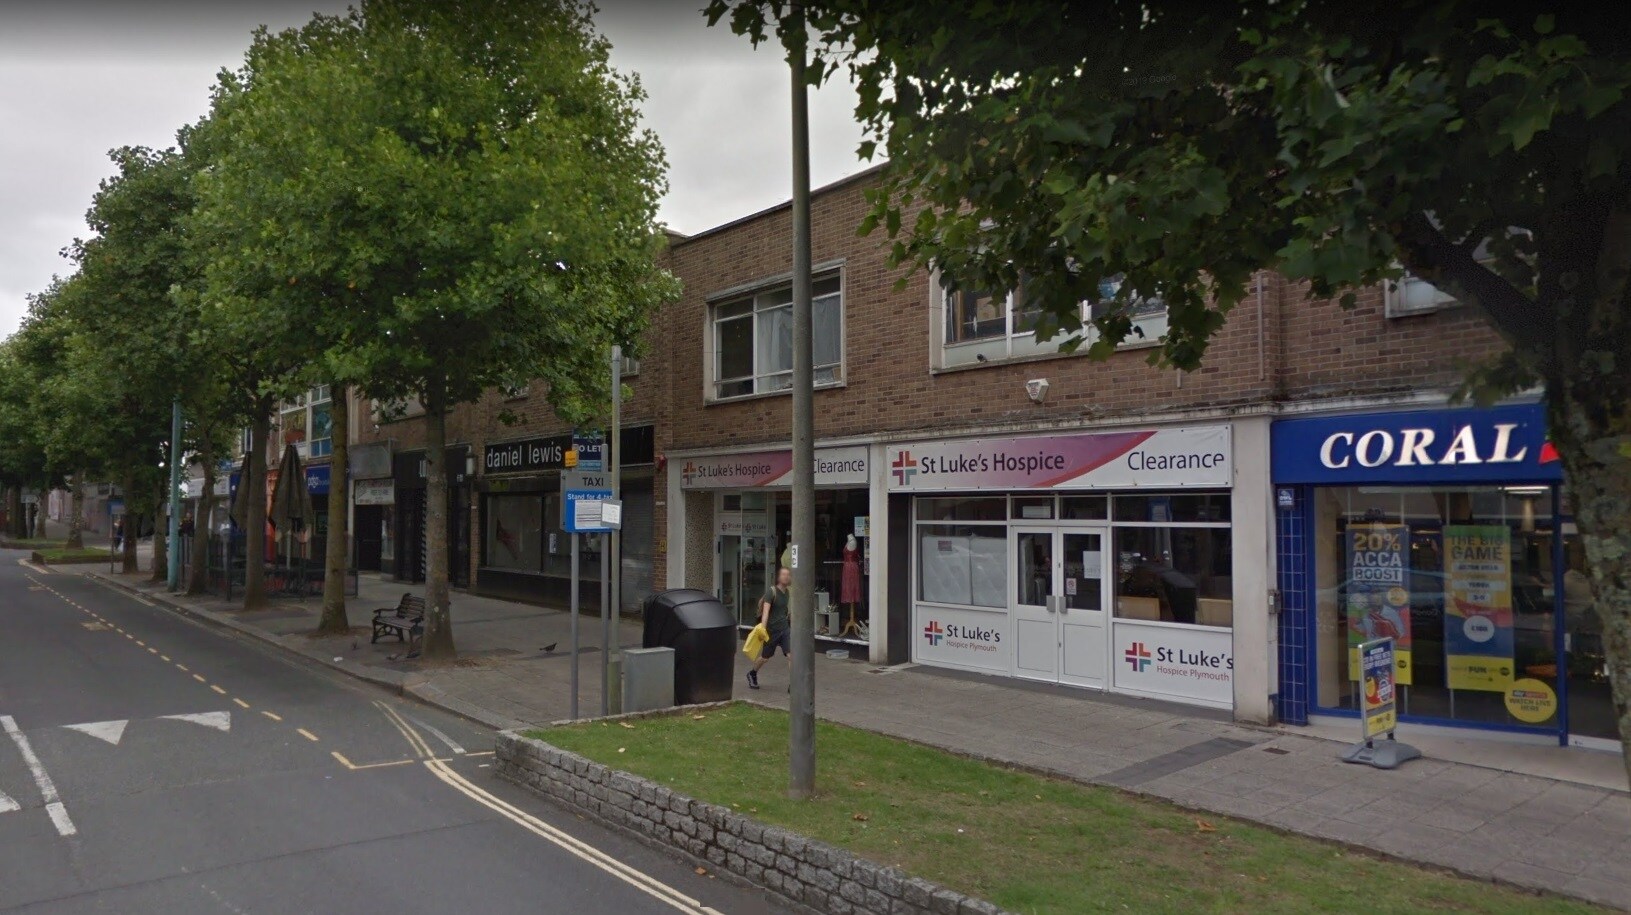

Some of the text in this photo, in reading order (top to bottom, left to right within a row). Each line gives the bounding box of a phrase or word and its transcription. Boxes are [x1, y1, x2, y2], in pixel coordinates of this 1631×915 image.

[487, 442, 562, 468] daniel lewis
[1320, 423, 1527, 469] CORAL
[921, 451, 1065, 475] St Luke's Hospice
[1127, 449, 1225, 471] Clearance
[697, 462, 771, 481] St Luke's Hospice
[582, 476, 604, 487] TAXI
[1353, 533, 1401, 552] 20%
[1353, 552, 1402, 567] ACCA
[1452, 547, 1503, 560] GAME
[1354, 568, 1401, 581] BOOST
[946, 624, 1001, 643] St Luke's
[946, 639, 997, 653] Hospice Plymouth
[1157, 646, 1233, 670] St Luke's
[1156, 665, 1230, 682] Hospice Plymouth
